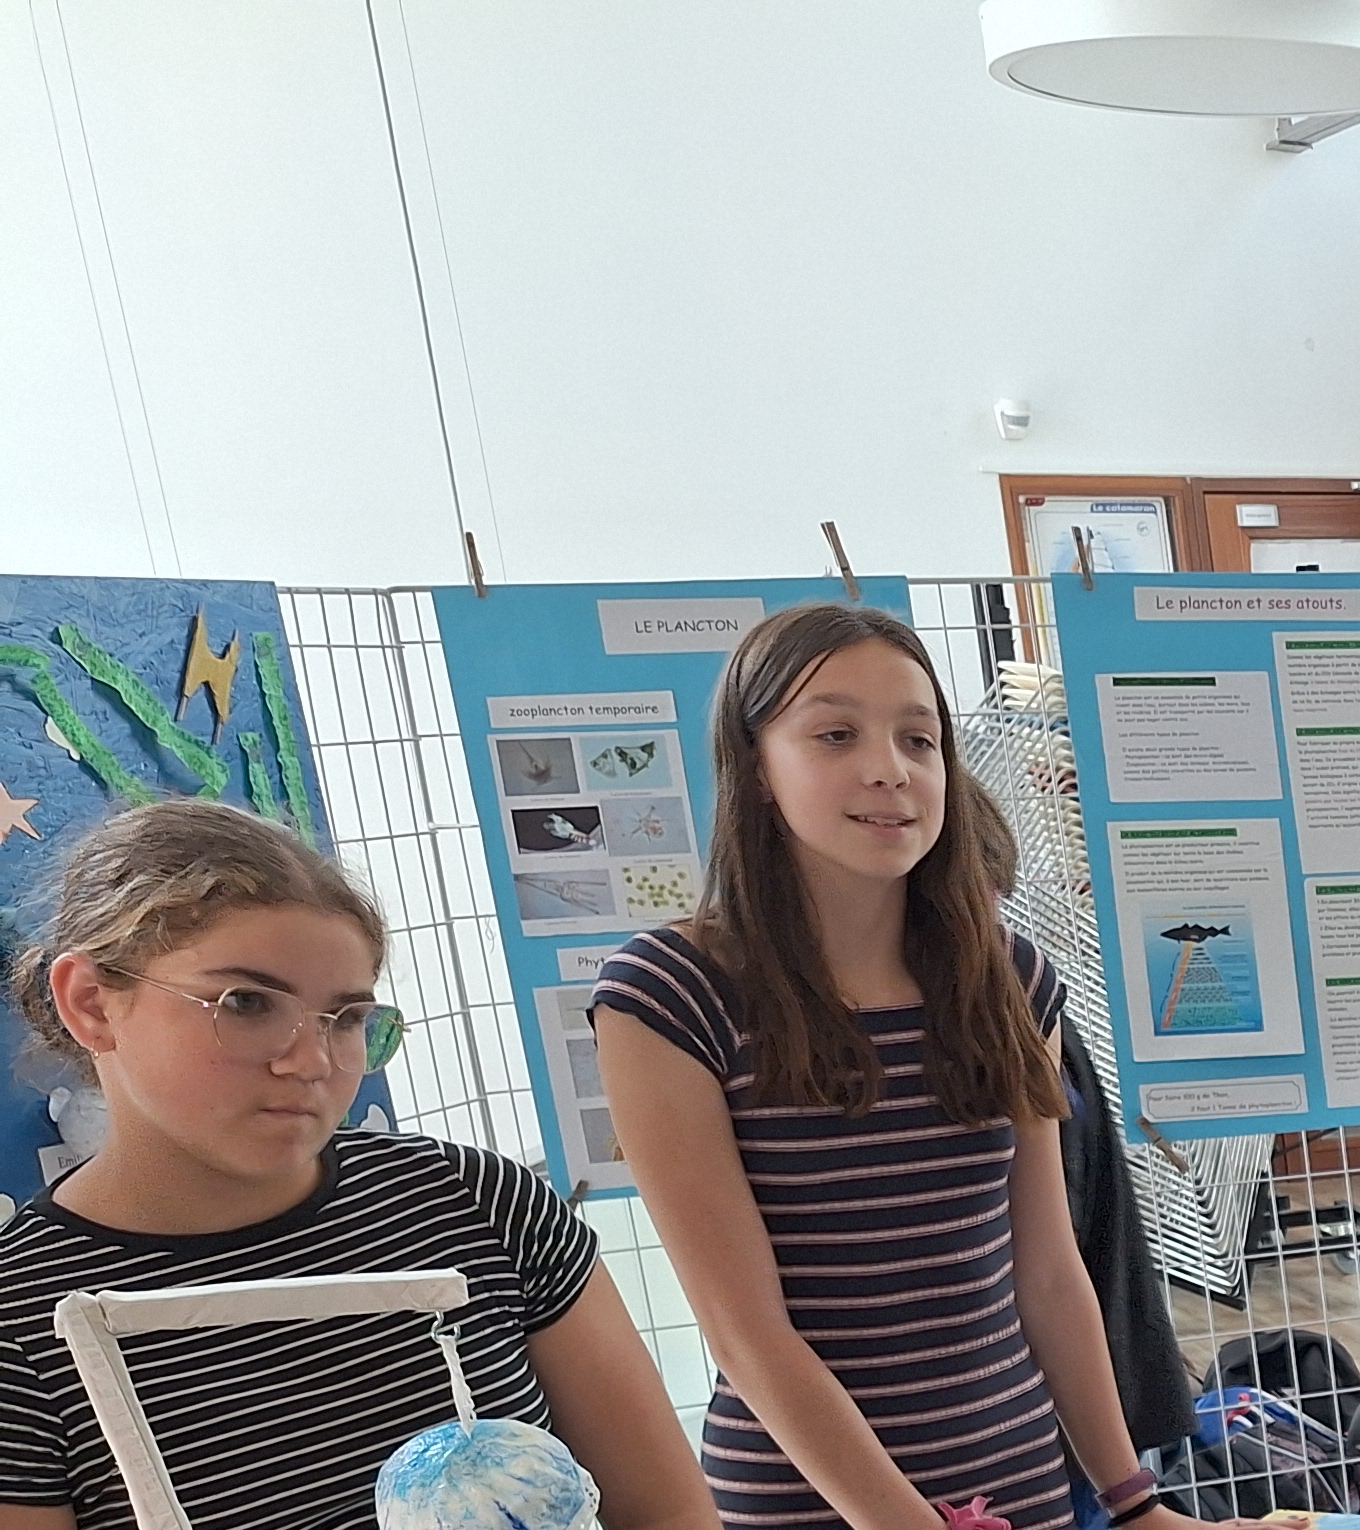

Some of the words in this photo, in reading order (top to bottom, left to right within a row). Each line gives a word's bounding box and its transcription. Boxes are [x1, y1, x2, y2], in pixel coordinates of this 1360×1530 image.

[1156, 595, 1174, 610] Le
[1179, 595, 1242, 613] plancton
[1246, 597, 1262, 610] et
[1267, 598, 1292, 610] ses
[1296, 597, 1347, 610] atouts.
[634, 620, 652, 633] LE
[657, 619, 739, 633] PLANCTON
[509, 704, 585, 719] zooplancton
[588, 703, 659, 718] temporaire
